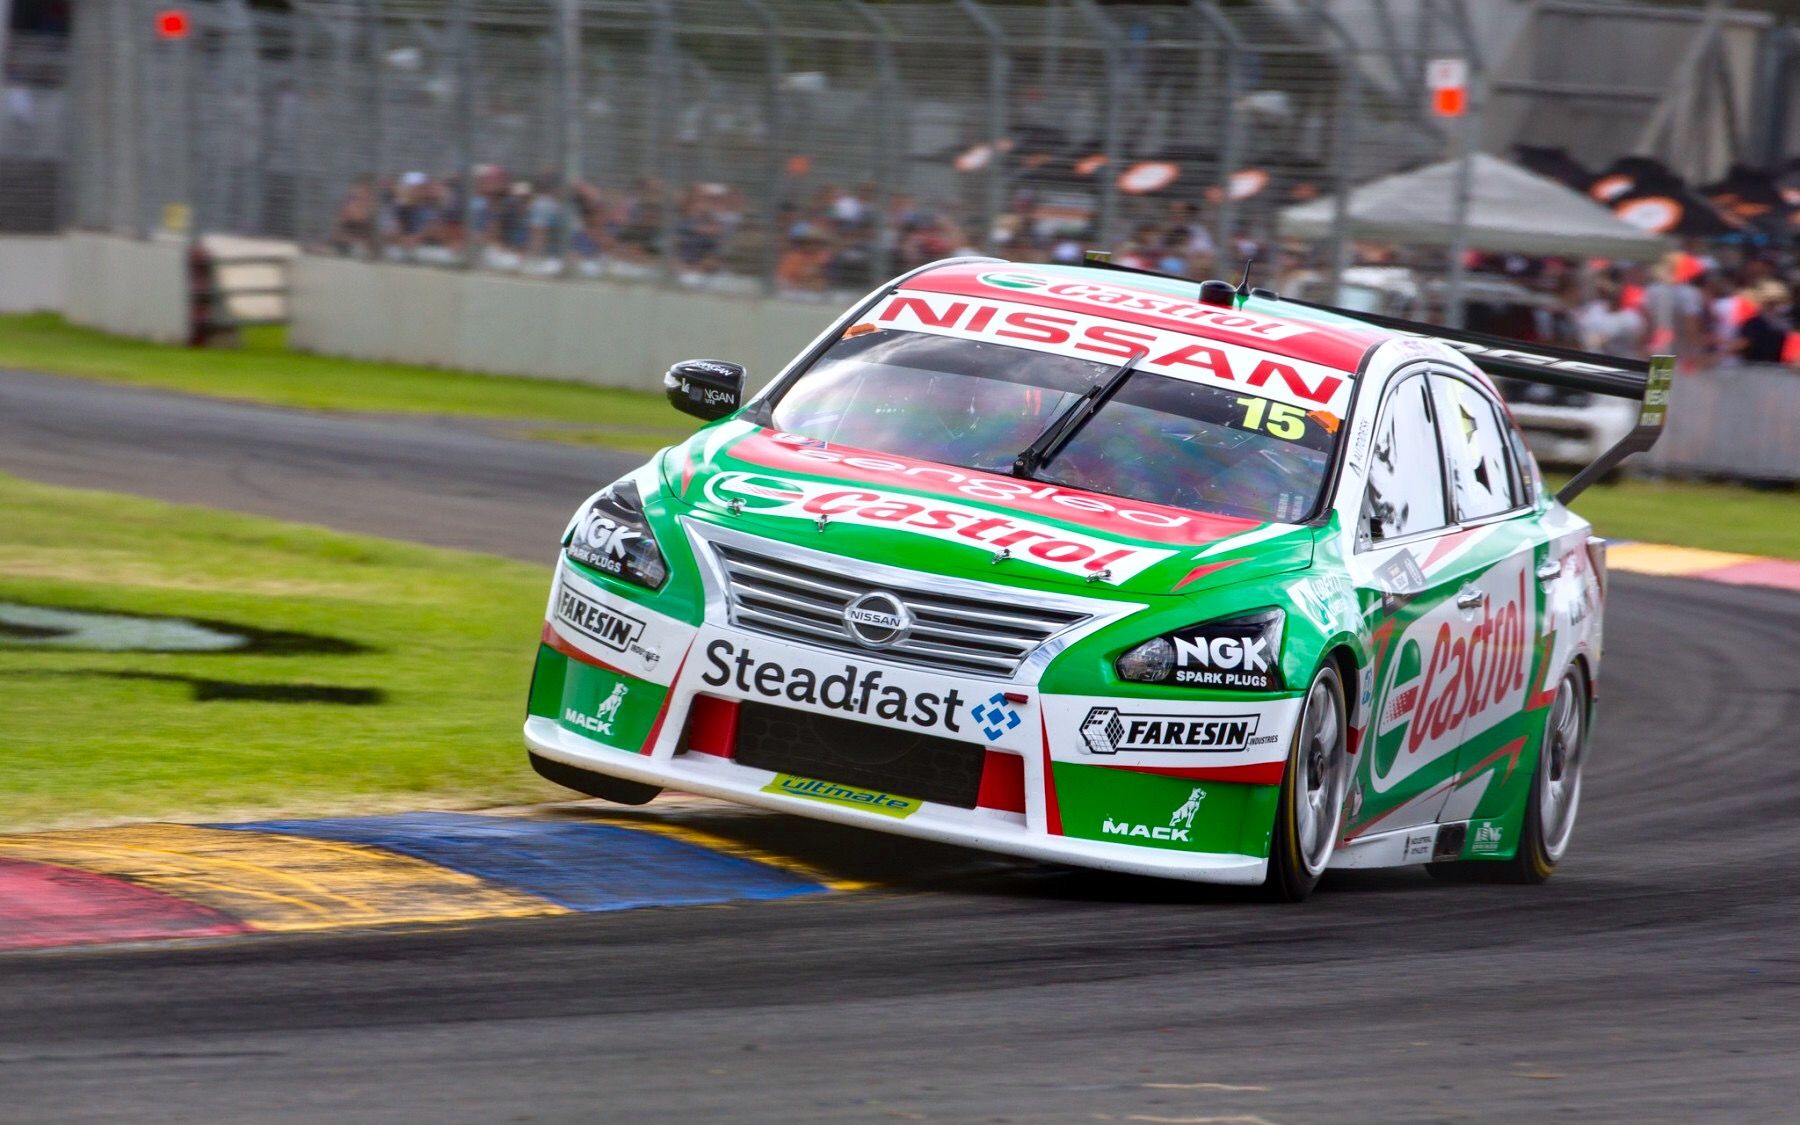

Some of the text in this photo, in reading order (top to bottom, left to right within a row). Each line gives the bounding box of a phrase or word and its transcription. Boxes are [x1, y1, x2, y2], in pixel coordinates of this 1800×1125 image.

[1047, 284, 1285, 336] Castrol
[879, 297, 1343, 404] NISSAN
[1236, 397, 1306, 441] 15
[797, 449, 1191, 528] sengled
[803, 491, 1138, 572] Castrol
[590, 554, 622, 573] PLUGS
[560, 592, 632, 645] FARESIN
[851, 611, 901, 627] NISSAN
[1173, 636, 1268, 673] NGK
[1408, 567, 1526, 754] Castrol
[701, 639, 964, 732] Steadfast
[1176, 671, 1268, 687] SPARK PLUGS
[565, 708, 612, 736] MACK
[1126, 720, 1279, 746] FARESIN INDUSTRIES
[782, 777, 909, 808] ultimate
[1102, 819, 1190, 842] MACK
